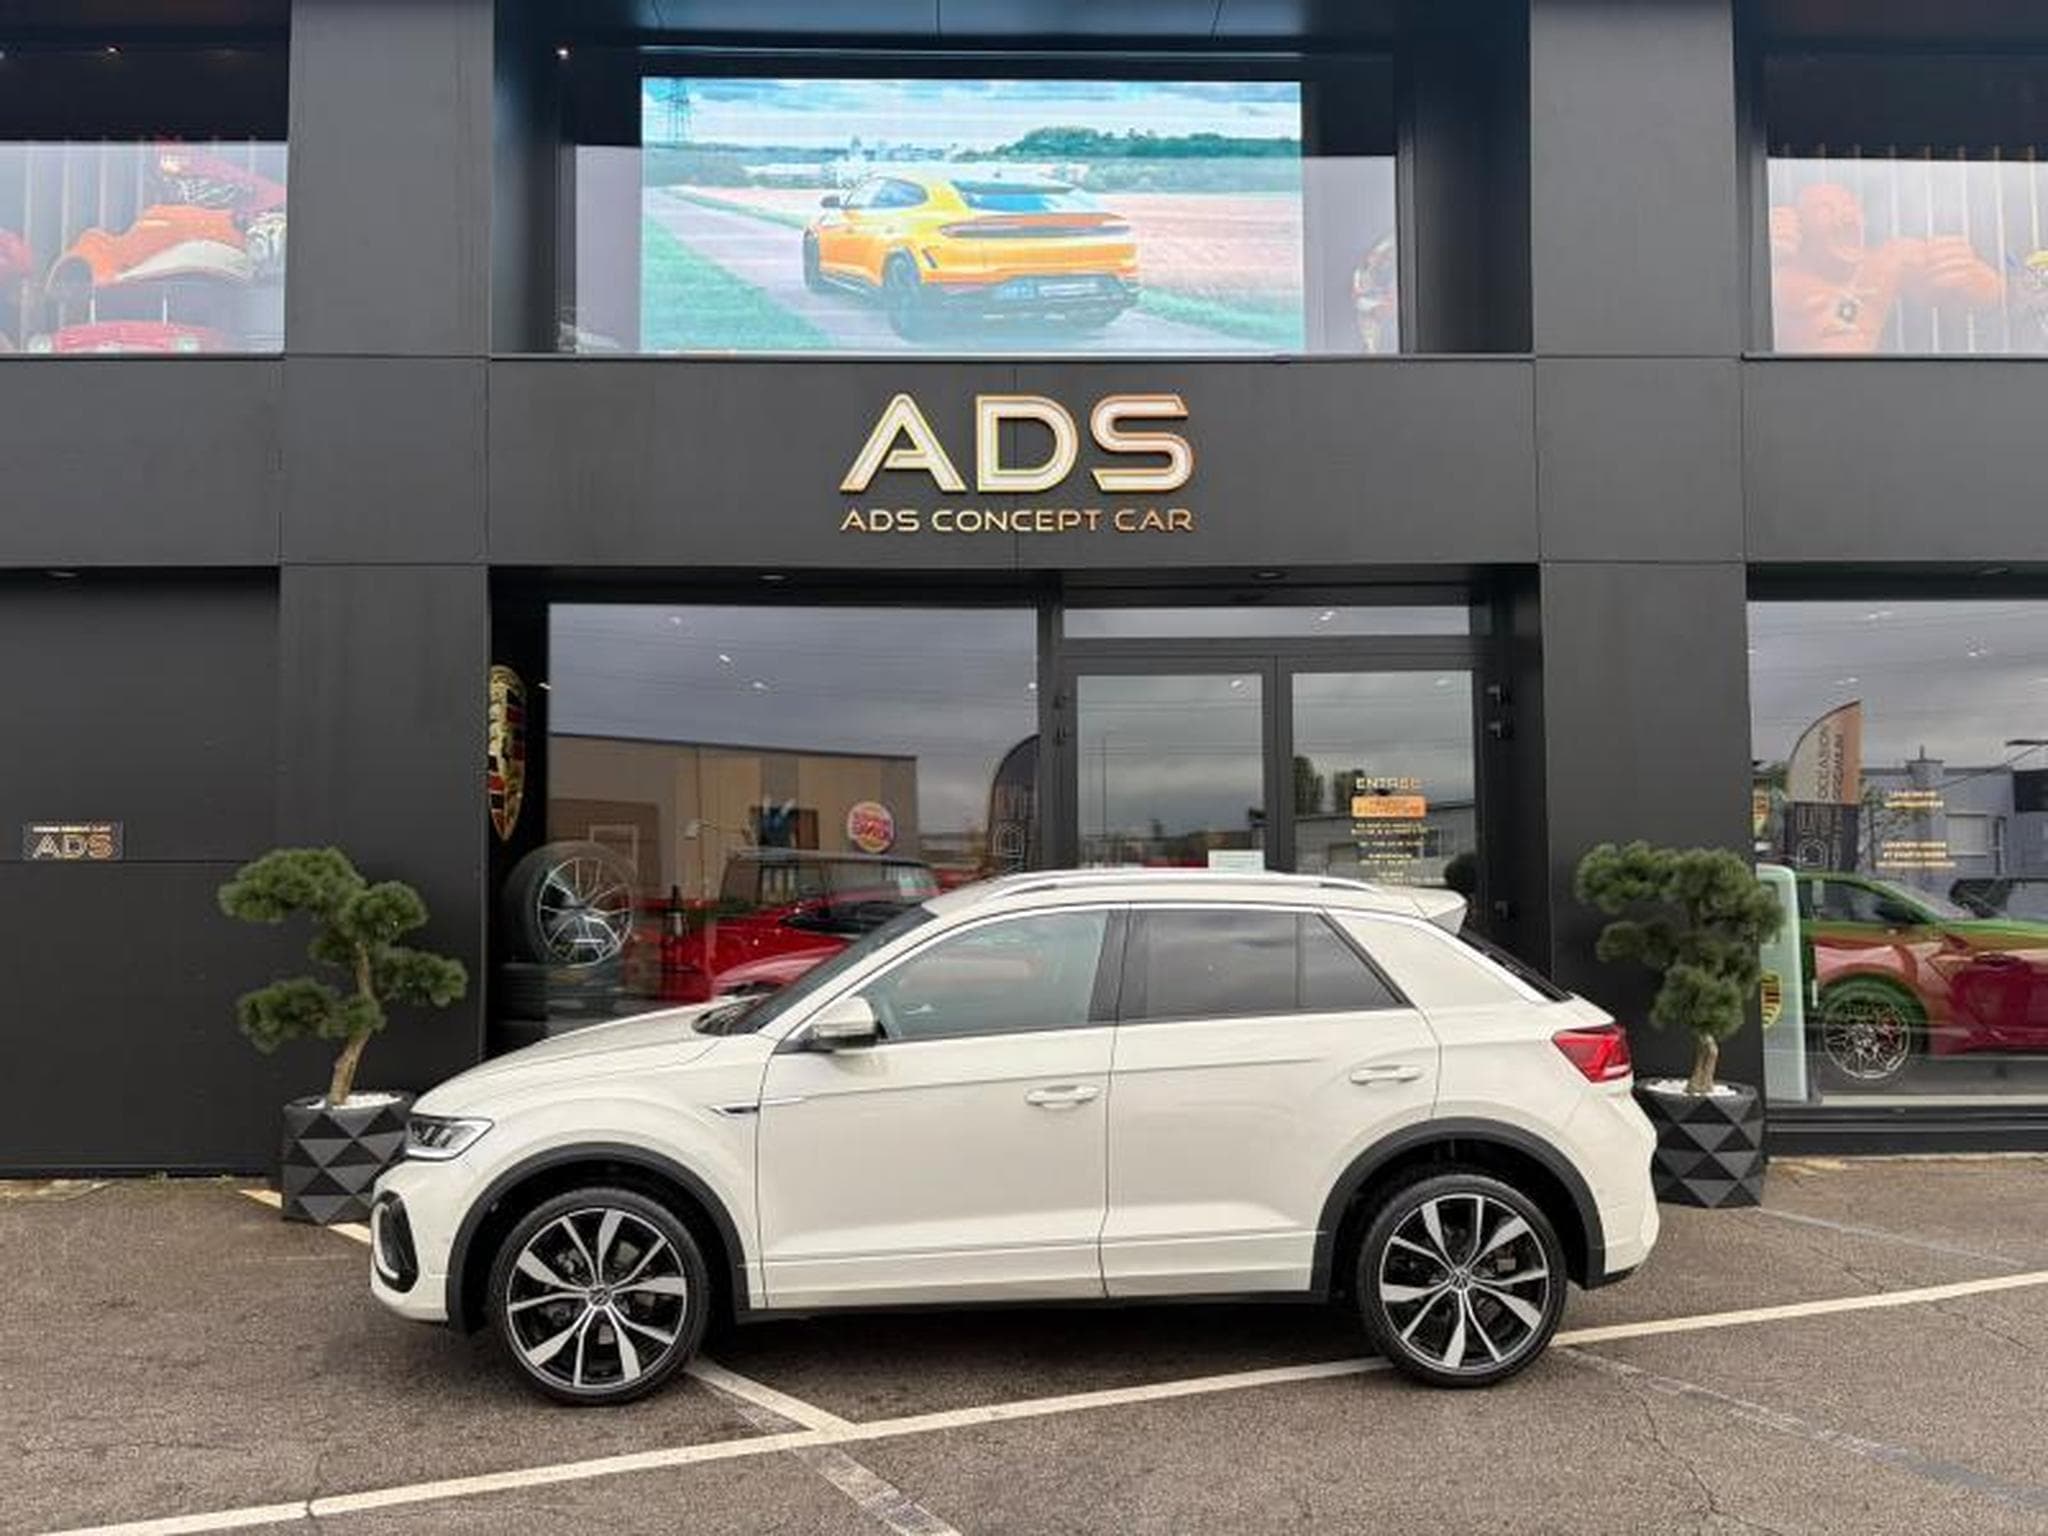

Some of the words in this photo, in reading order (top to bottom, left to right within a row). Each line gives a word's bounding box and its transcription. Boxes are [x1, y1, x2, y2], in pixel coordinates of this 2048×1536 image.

[839, 393, 1193, 491] ADS
[840, 509, 920, 532] ADS
[931, 509, 1102, 532] CONCEPT
[1114, 509, 1193, 532] CAR
[32, 834, 113, 859] ADS
